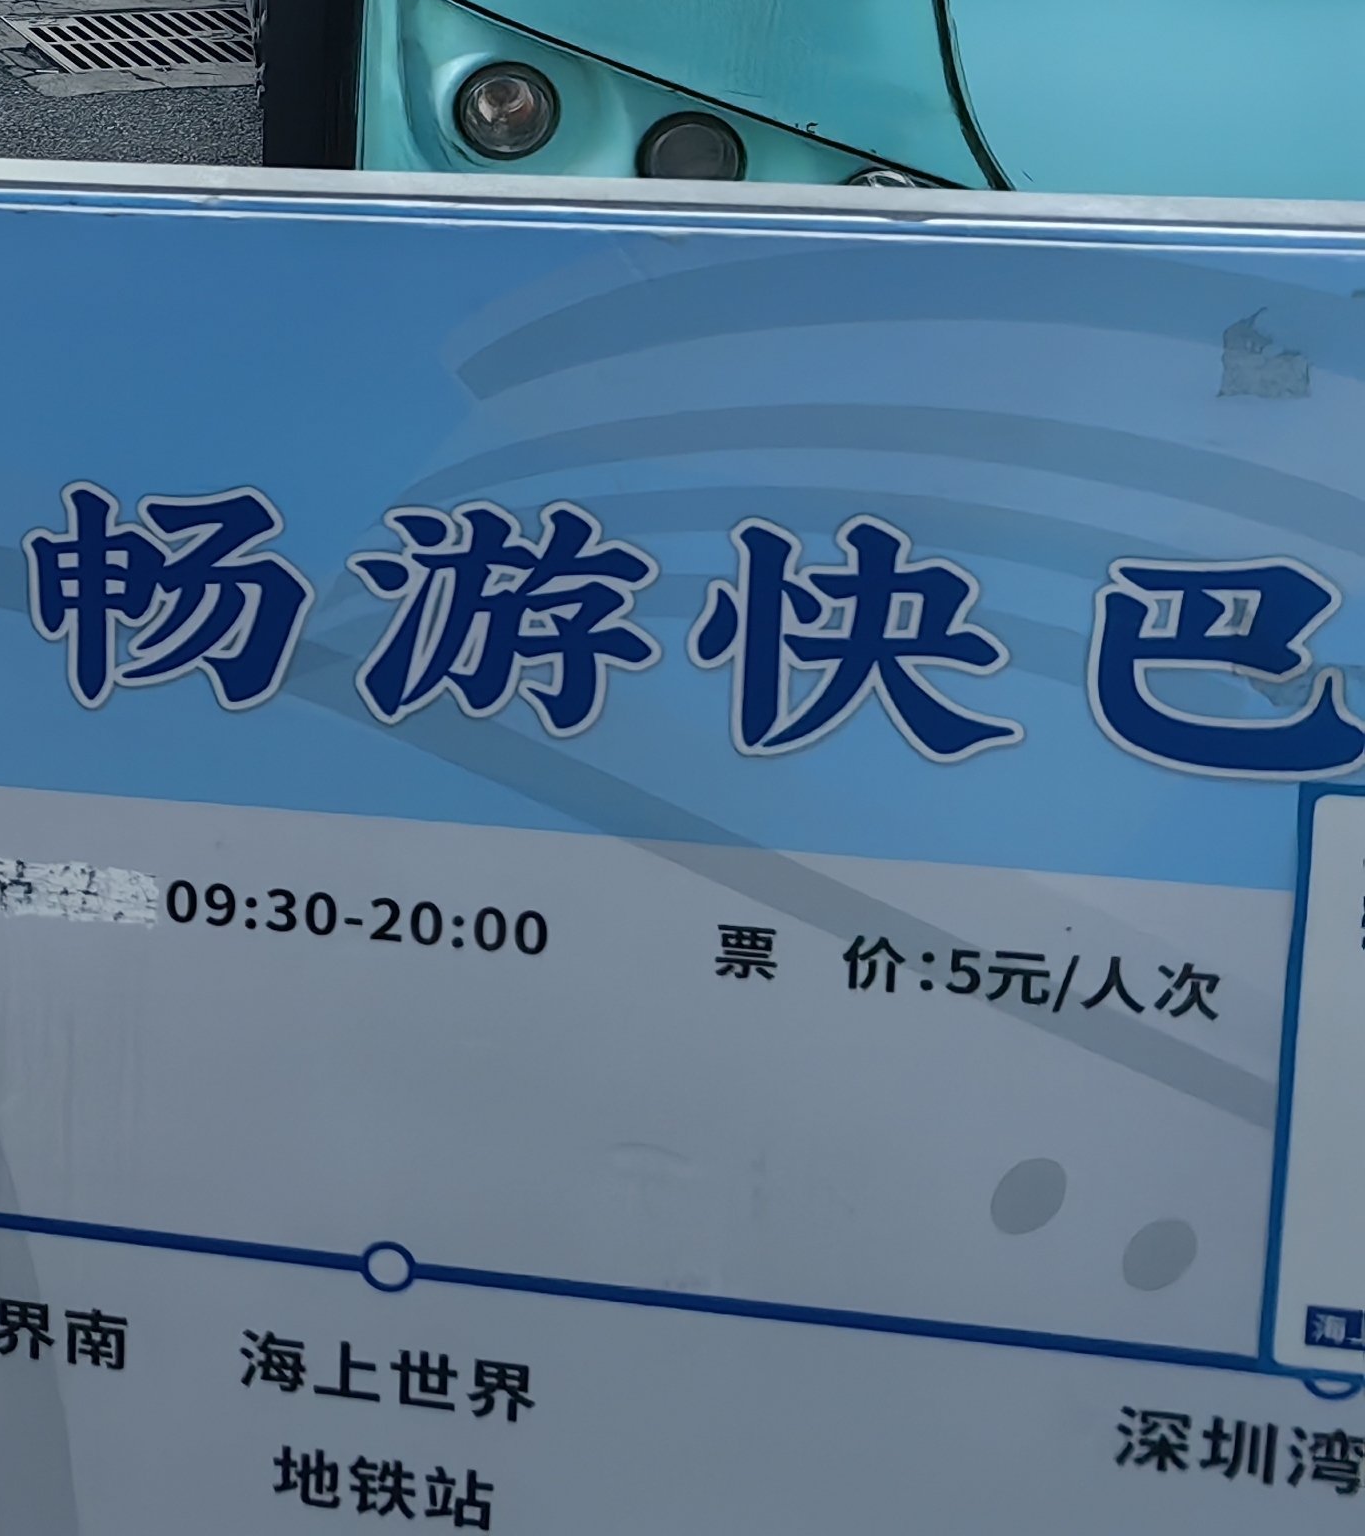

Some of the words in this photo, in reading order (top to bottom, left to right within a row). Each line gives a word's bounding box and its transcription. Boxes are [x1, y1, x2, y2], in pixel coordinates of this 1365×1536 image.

[166, 878, 550, 956] 09:30-20:00
[239, 1328, 537, 1424] 海上世界
[272, 1445, 495, 1532] 地铁站
[1115, 1405, 1365, 1497] 深圳湾
